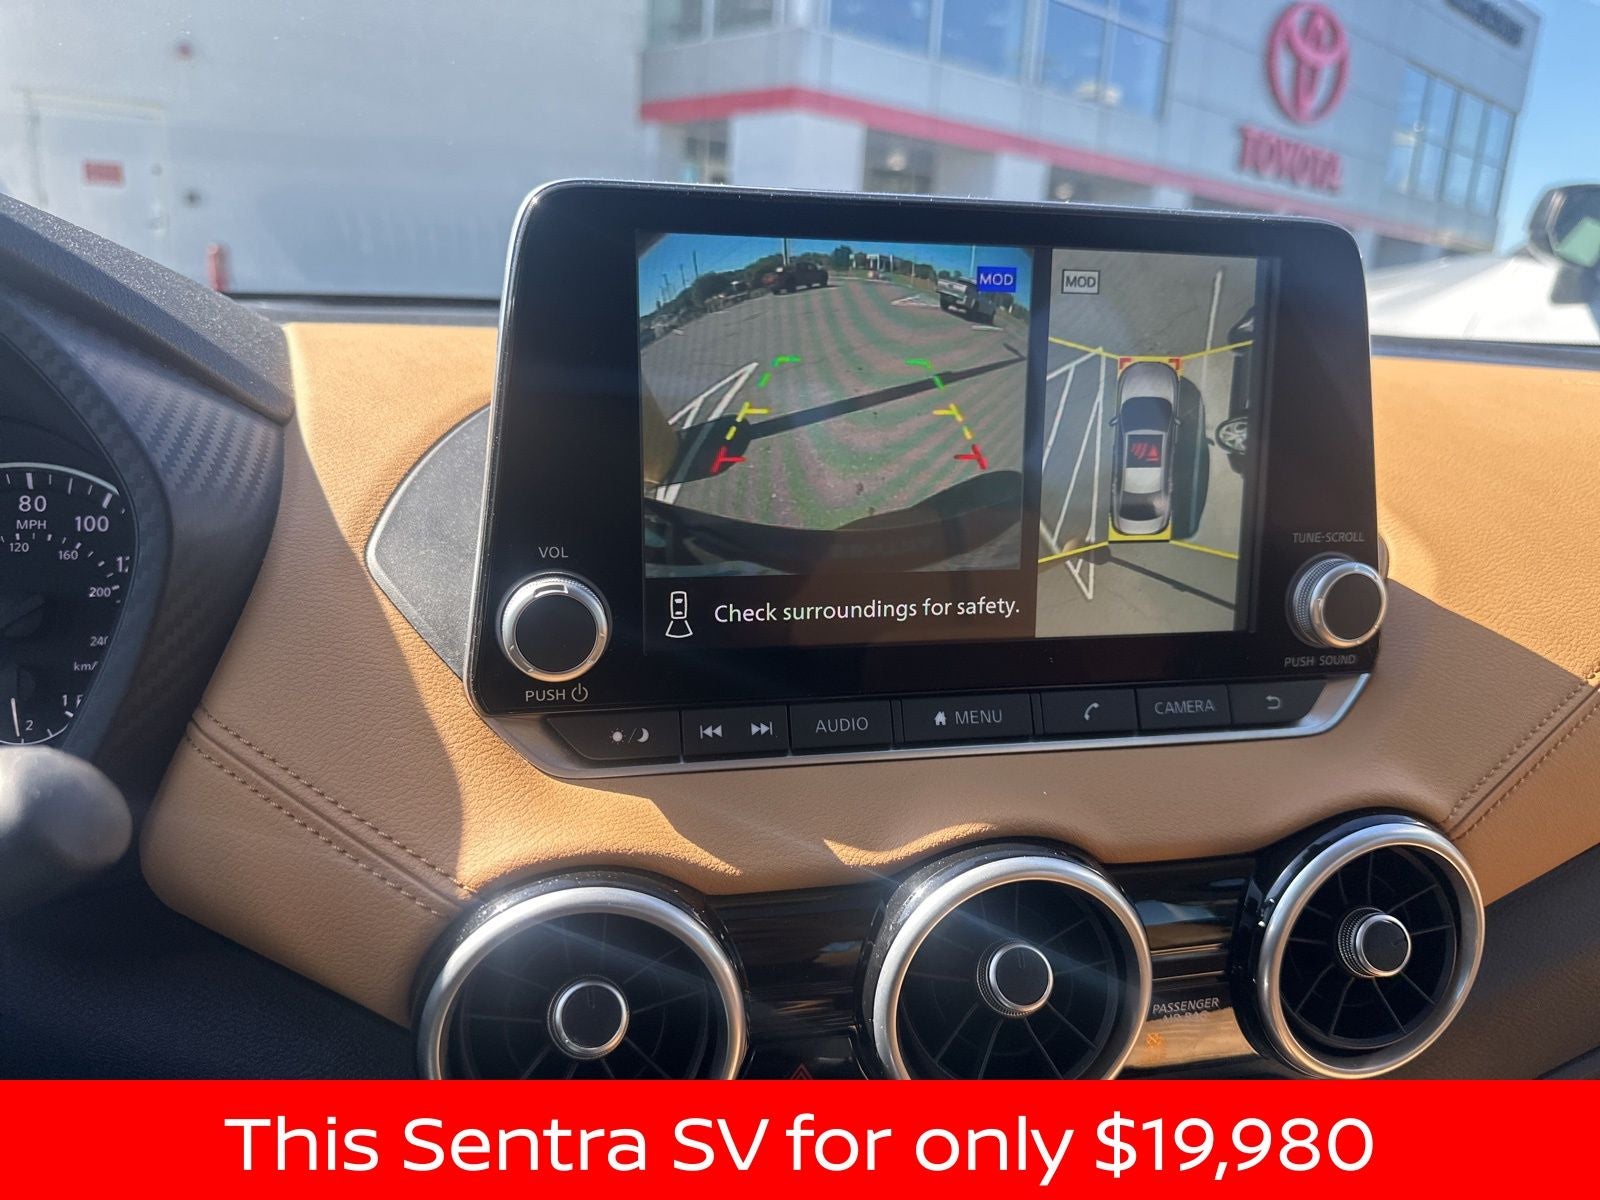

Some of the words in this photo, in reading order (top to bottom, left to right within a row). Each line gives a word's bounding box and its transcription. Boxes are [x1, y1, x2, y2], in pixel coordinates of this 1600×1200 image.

[1239, 124, 1342, 192] TOYOTA
[979, 273, 1014, 286] MOD
[1065, 276, 1097, 288] MOD
[18, 495, 47, 512] 80
[16, 519, 47, 530] MPH
[74, 515, 109, 532] 100
[9, 542, 30, 552] 120
[538, 546, 569, 559] VOL
[58, 550, 79, 560] 160
[89, 587, 112, 598] 200
[714, 602, 778, 623] Check
[782, 599, 918, 622] surroundings
[922, 598, 953, 616] for
[956, 596, 1020, 618] safety.
[1283, 656, 1315, 668] PUSH
[1319, 654, 1357, 666] SOUND
[525, 689, 566, 702] PUSH
[1154, 699, 1215, 715] CAMERA
[955, 709, 1003, 725] MENU
[815, 717, 869, 734] AUDIO
[1151, 997, 1220, 1015] PASSENGER
